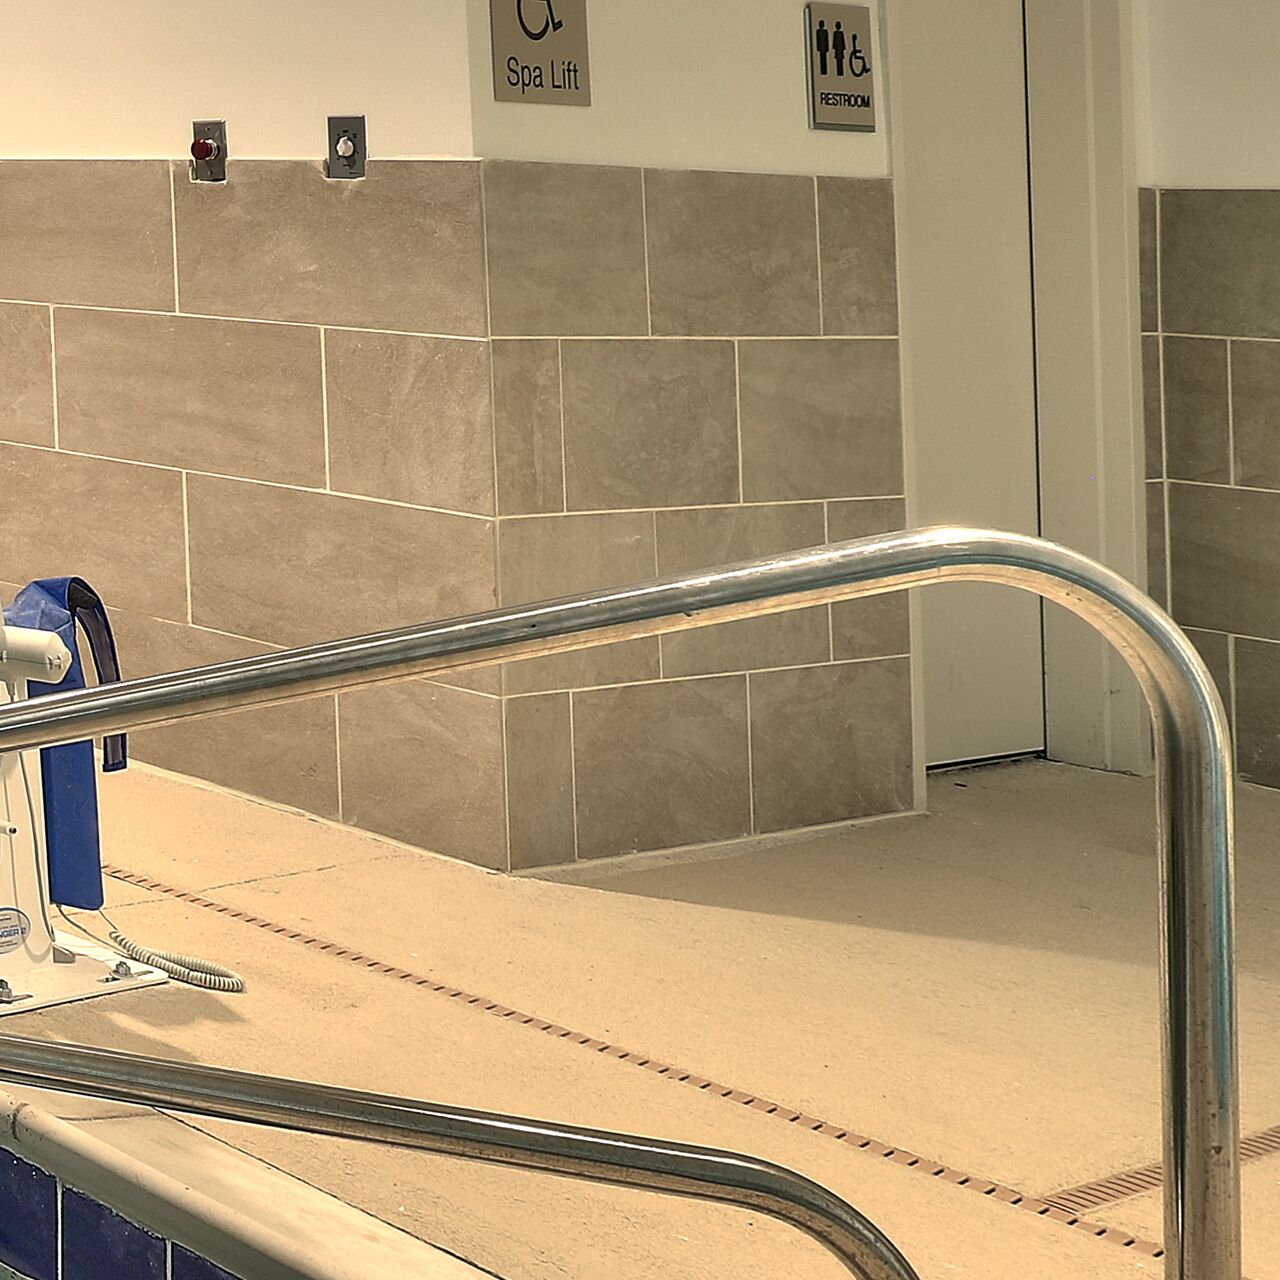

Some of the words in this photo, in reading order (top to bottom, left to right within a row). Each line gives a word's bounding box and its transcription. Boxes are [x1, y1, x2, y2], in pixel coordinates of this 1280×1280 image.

[506, 56, 544, 95] Spa
[552, 59, 580, 91] Lift
[820, 92, 871, 109] RESTROOM
